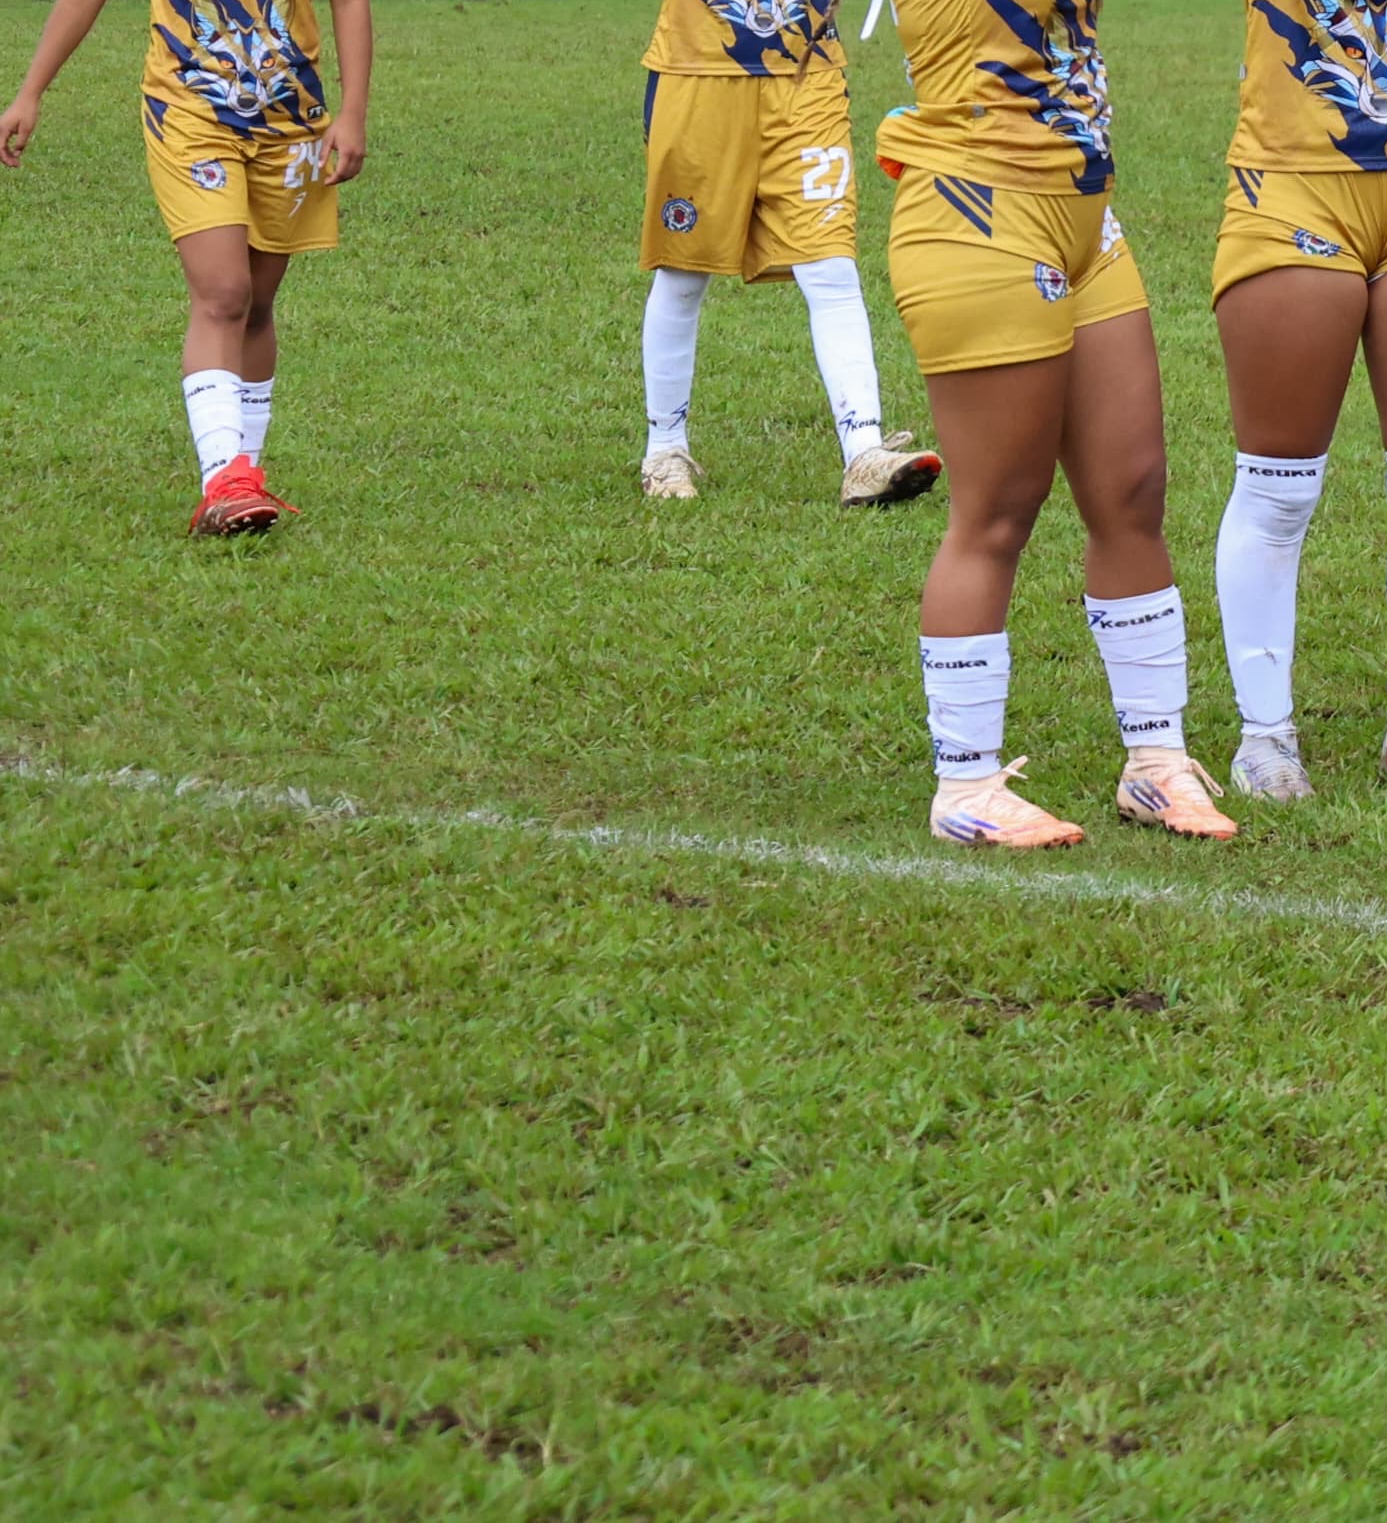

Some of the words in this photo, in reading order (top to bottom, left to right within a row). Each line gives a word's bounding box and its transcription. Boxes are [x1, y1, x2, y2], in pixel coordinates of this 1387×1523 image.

[284, 139, 323, 189] 24
[800, 145, 851, 202] 27
[1248, 465, 1318, 478] Keuka
[1099, 606, 1176, 630] Keuka
[924, 659, 989, 670] Keuka
[1121, 717, 1172, 734] Keuka
[937, 751, 982, 764] Keuka
